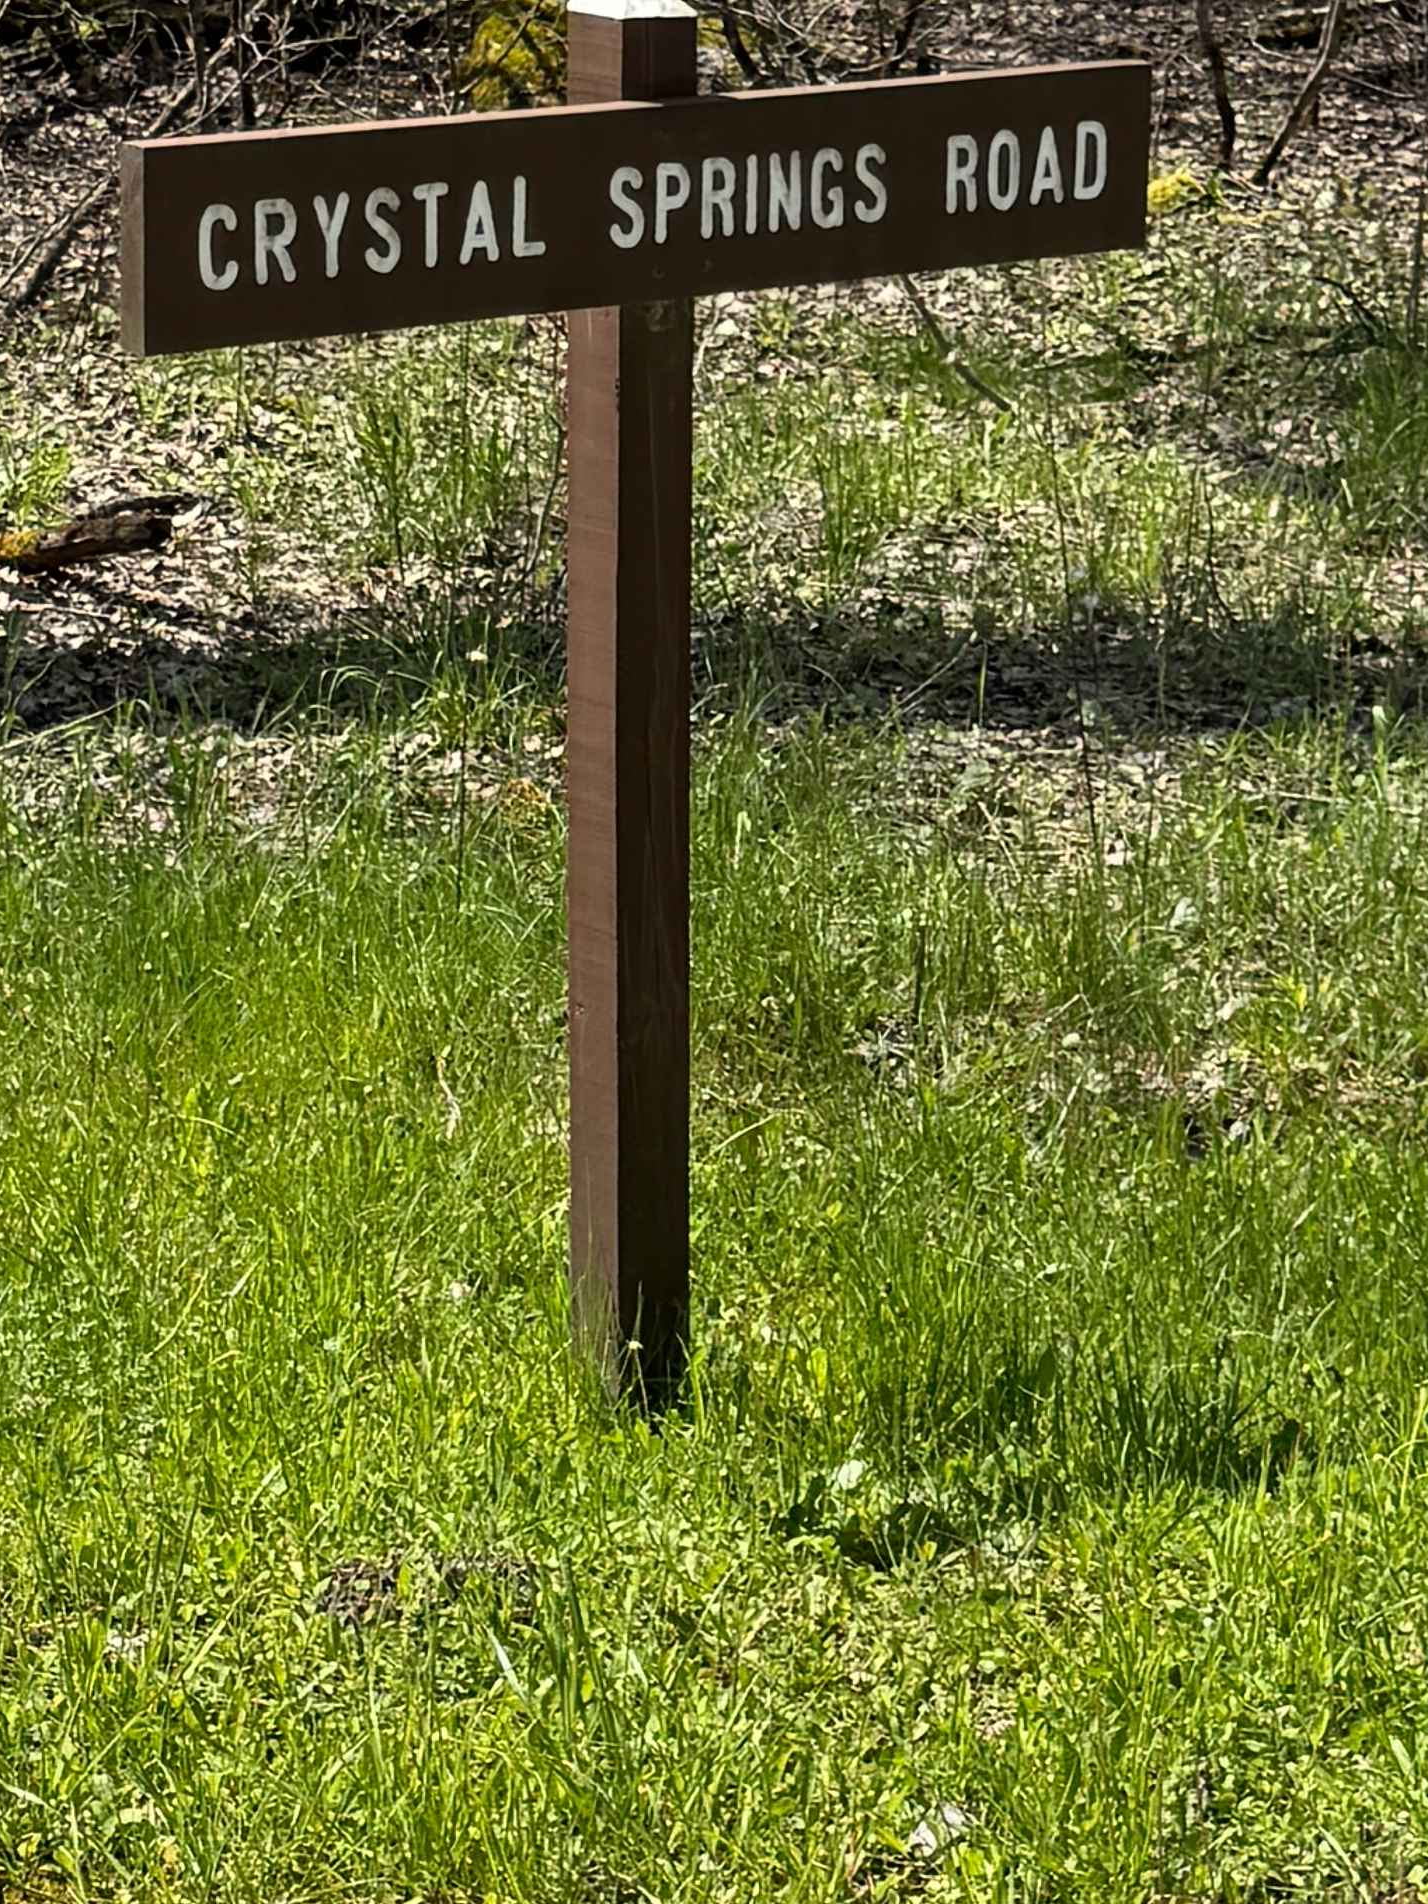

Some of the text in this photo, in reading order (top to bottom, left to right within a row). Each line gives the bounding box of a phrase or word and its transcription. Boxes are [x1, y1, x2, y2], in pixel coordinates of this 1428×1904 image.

[197, 119, 1109, 291] CRYSTAL SPRINGS ROAD
